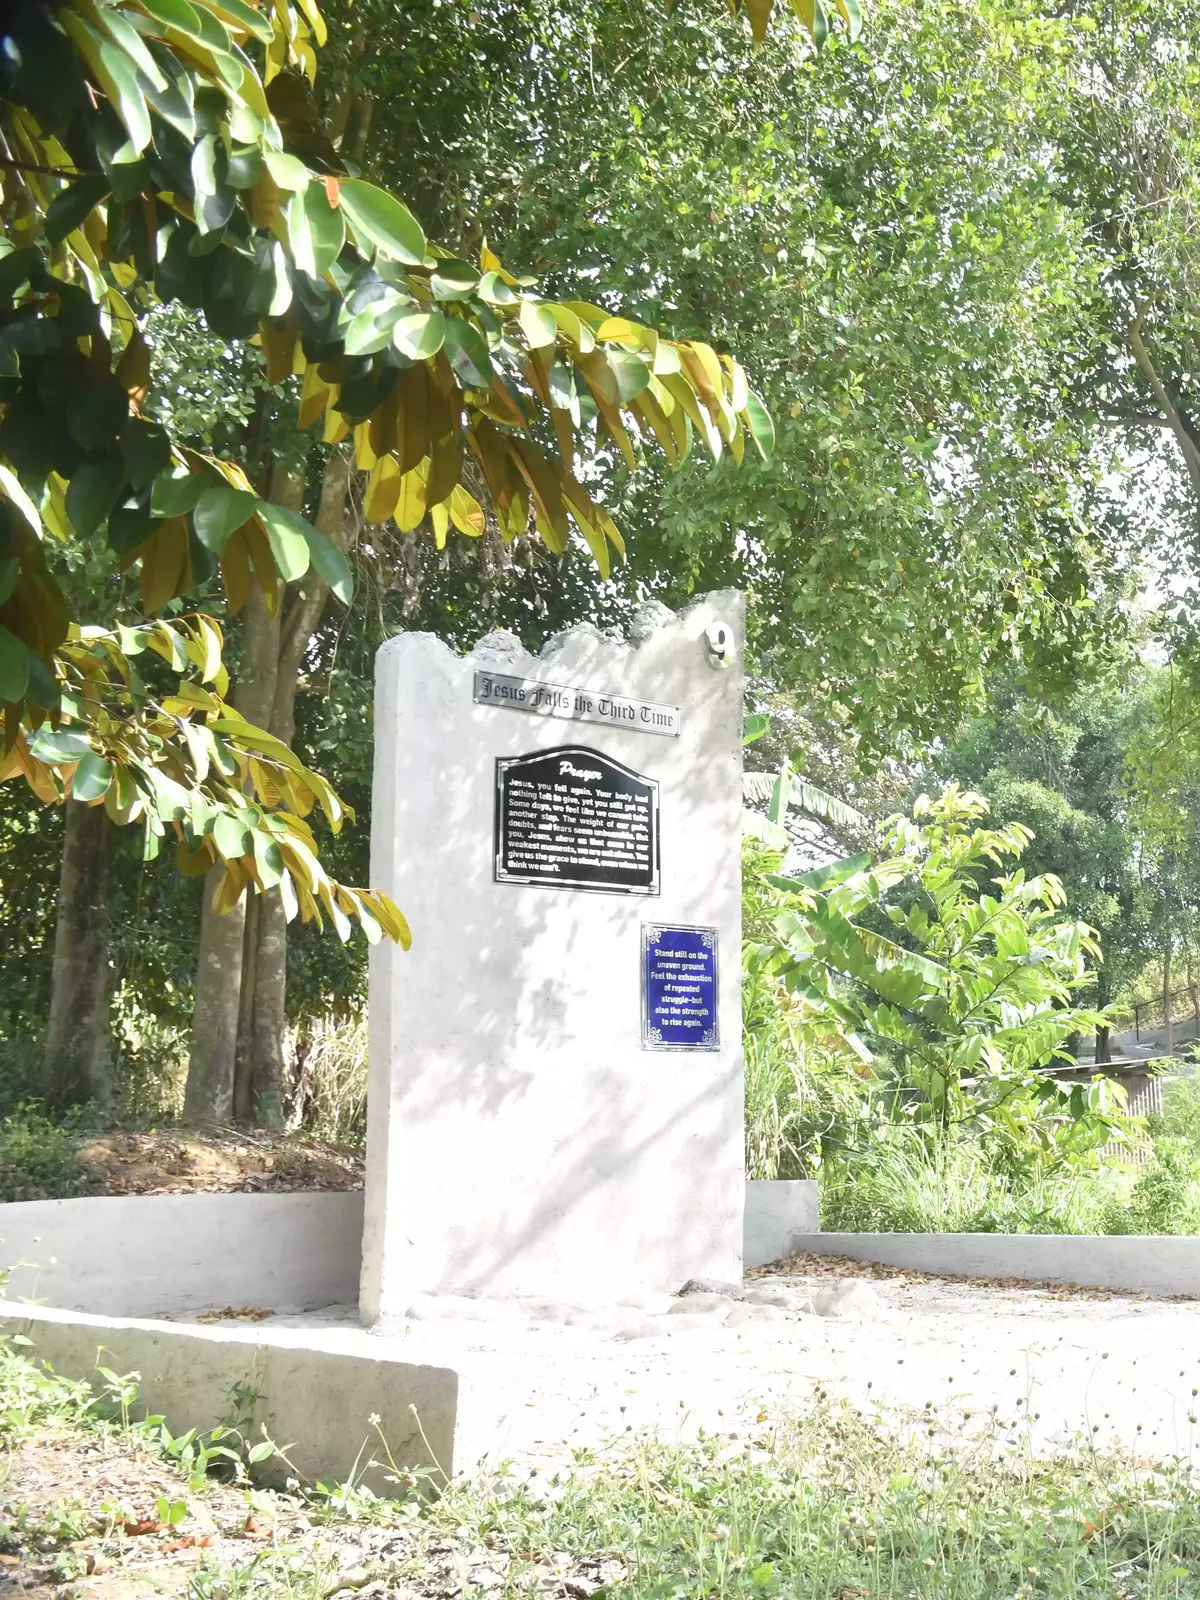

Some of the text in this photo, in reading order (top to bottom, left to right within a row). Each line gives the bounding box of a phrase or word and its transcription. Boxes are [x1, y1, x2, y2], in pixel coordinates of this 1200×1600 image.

[704, 620, 736, 670] 9
[482, 677, 673, 727] Jesus Falls the Third Time
[559, 760, 603, 782] Prayer
[509, 779, 534, 789] Jesus,
[554, 784, 567, 792] fell
[571, 787, 592, 795] again.
[596, 789, 612, 798] Your
[615, 792, 632, 802] body
[509, 790, 537, 799] nothing
[539, 792, 552, 800] left
[563, 796, 580, 804] give,
[595, 800, 608, 808] you
[609, 801, 623, 809] still
[509, 799, 529, 807] Some
[532, 801, 552, 811] days,
[553, 804, 564, 812] we
[566, 805, 579, 813] feel
[581, 807, 594, 815] like
[509, 810, 538, 818] another
[541, 813, 559, 822] step.
[563, 815, 576, 823] The
[580, 818, 603, 827] weight
[508, 819, 536, 829] doubts,
[553, 824, 572, 832] fears
[574, 827, 593, 835] seem
[528, 831, 552, 841] Jesus,
[556, 834, 575, 842] show
[508, 840, 539, 849] weakest
[541, 844, 576, 854] moments,
[508, 850, 524, 859] give
[535, 853, 547, 861] the
[548, 855, 569, 863] grace
[508, 860, 527, 868] think
[655, 949, 673, 957] Stand
[682, 963, 705, 971] ground.
[678, 974, 712, 982] exhaustion
[672, 985, 699, 993] repeated
[682, 1008, 708, 1016] strength
